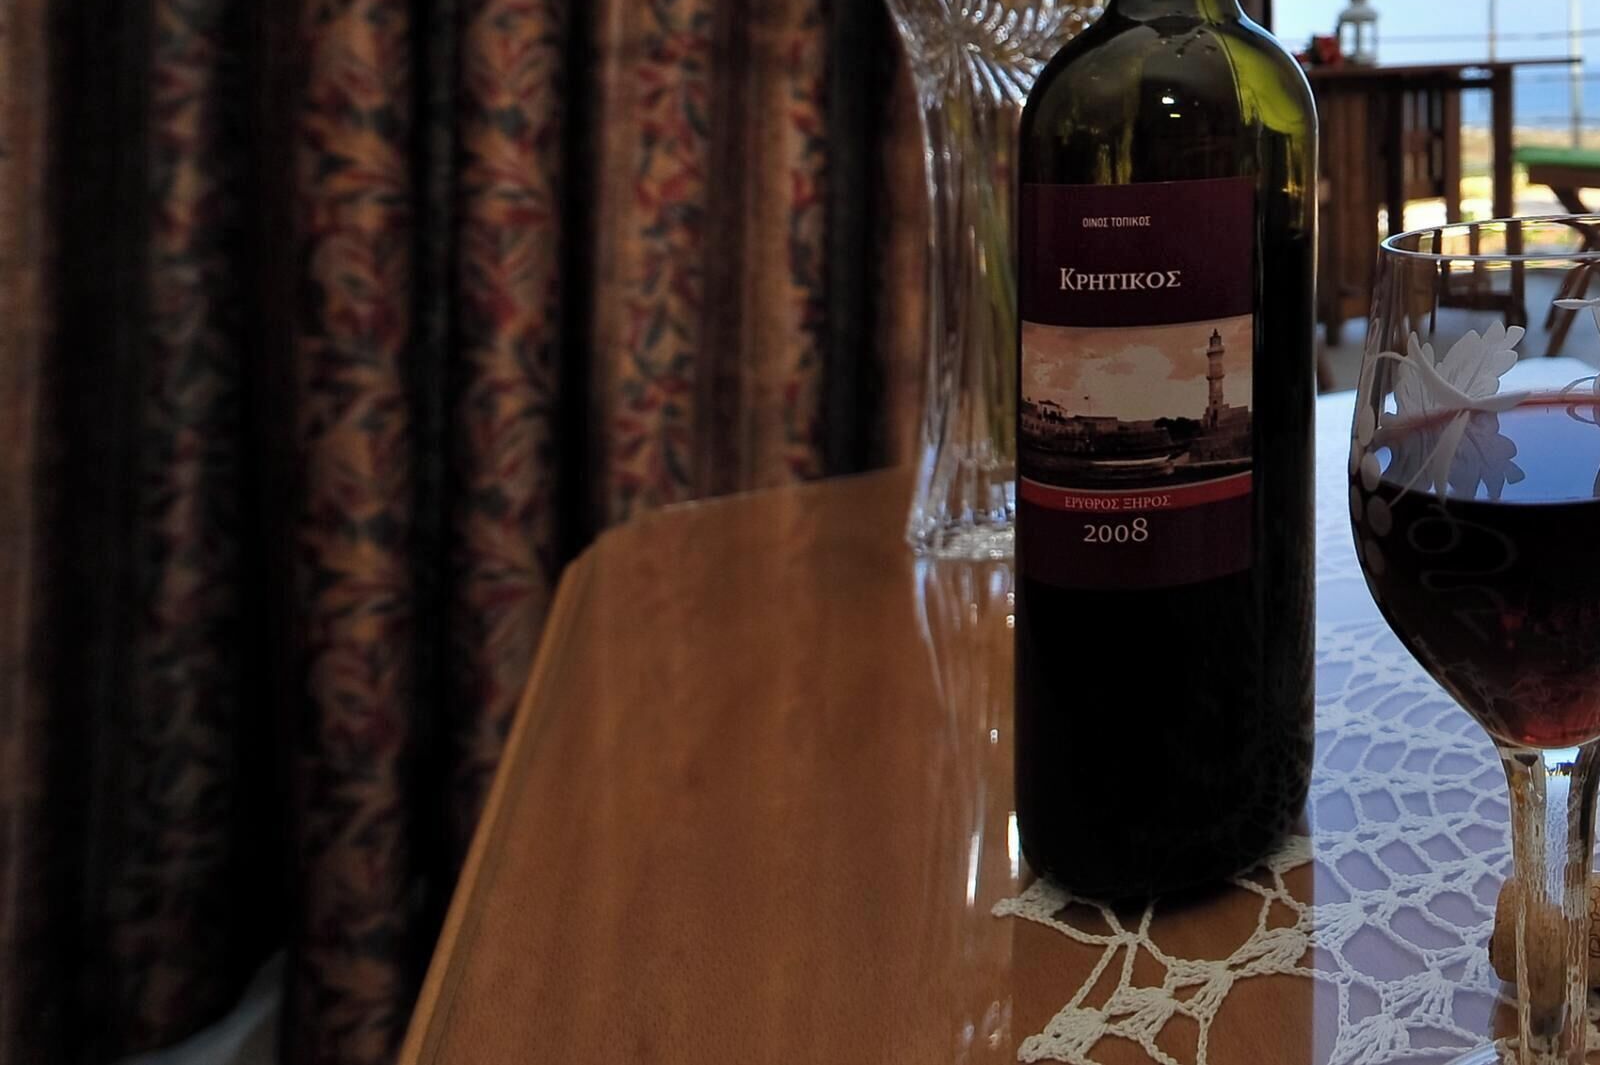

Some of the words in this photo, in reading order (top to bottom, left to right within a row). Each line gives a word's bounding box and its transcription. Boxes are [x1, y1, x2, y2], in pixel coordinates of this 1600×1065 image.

[1082, 217, 1108, 228] ΟΙΝΟΣ
[1111, 215, 1151, 228] ΤΟΠΙΚΟΣ
[1065, 496, 1120, 510] ΕΡΥΘΡΟΣ
[1122, 495, 1171, 510] ΞΗΡΟΣ
[1083, 517, 1149, 543] 2008
